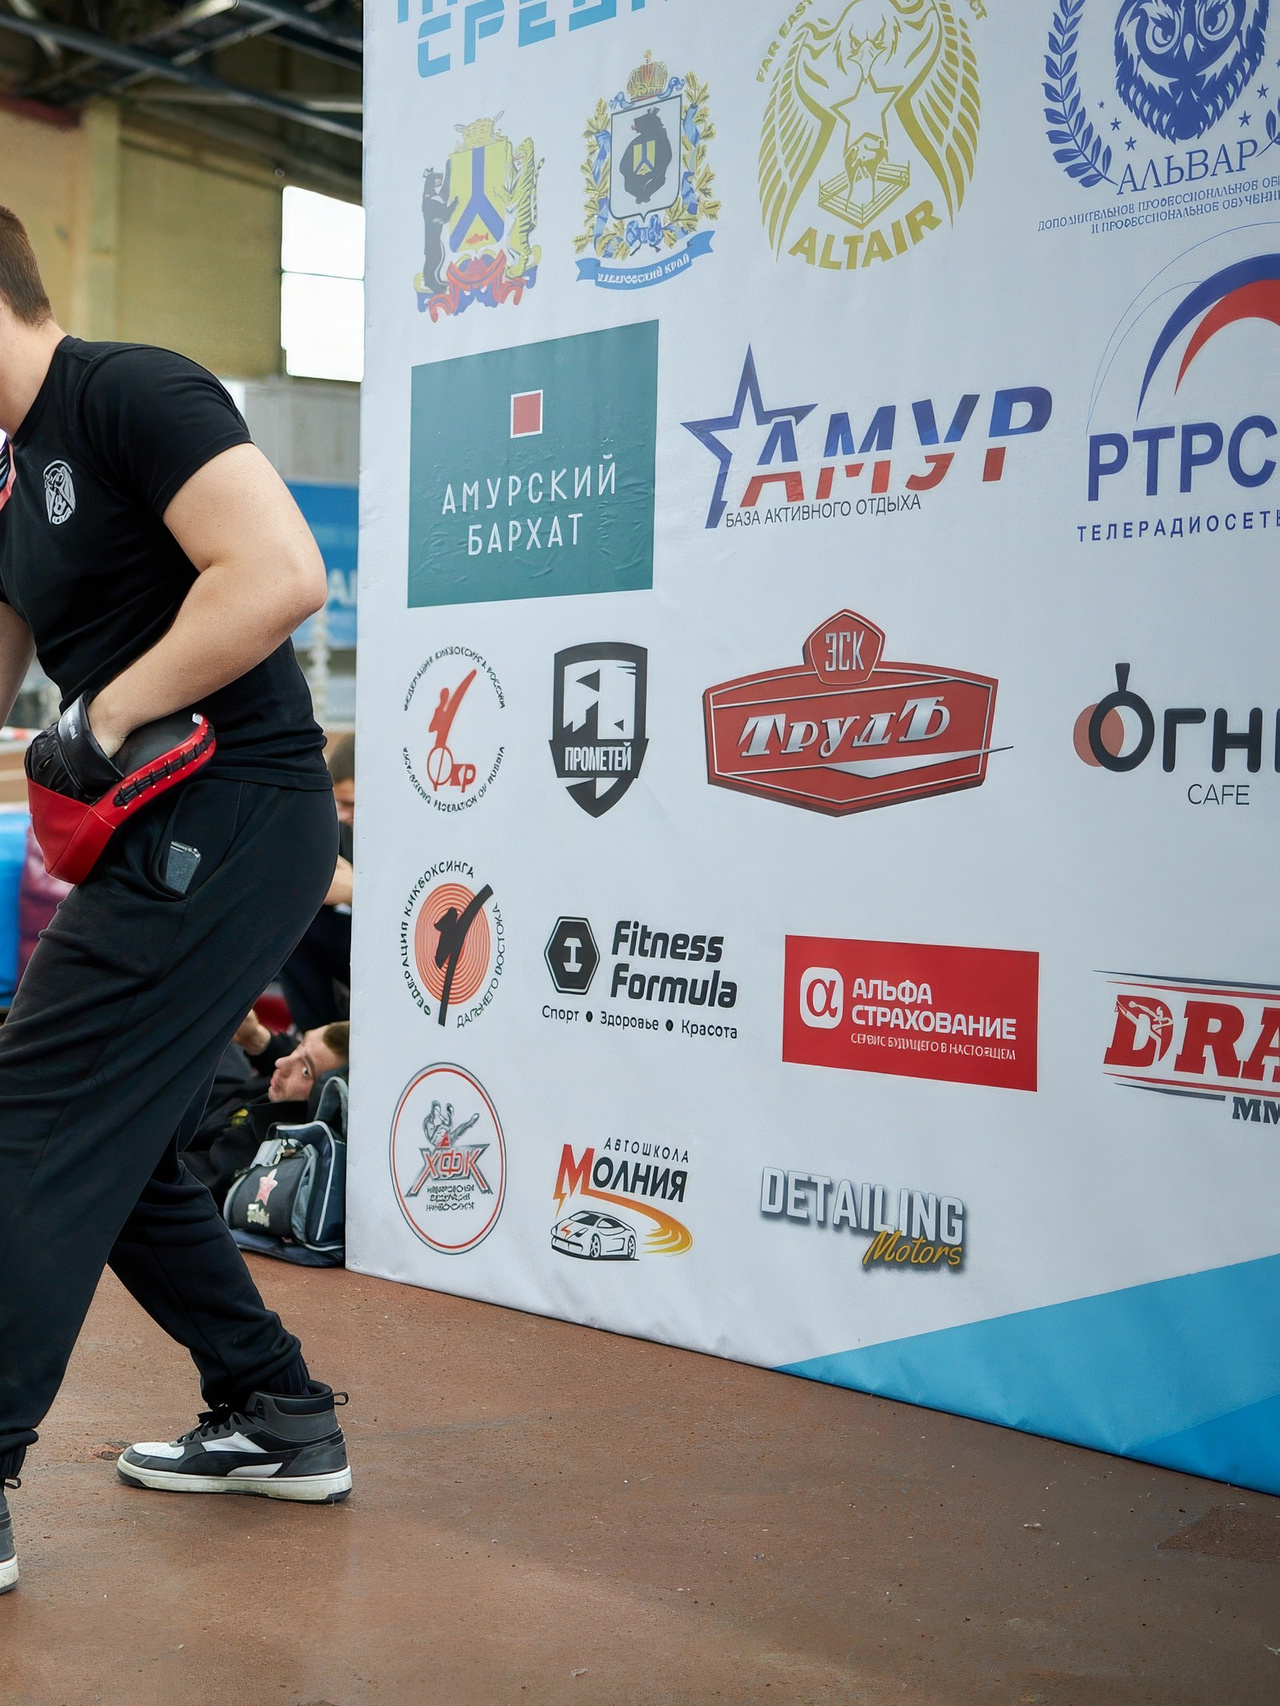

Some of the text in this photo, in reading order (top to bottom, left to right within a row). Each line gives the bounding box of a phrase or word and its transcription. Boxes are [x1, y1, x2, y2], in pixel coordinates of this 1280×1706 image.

[1116, 138, 1259, 196] АЛЬВАР
[1262, 174, 1280, 189] ОБ
[789, 199, 943, 270] ALTAIR
[739, 385, 1053, 508] АМУР
[1088, 415, 1278, 502] РТРС
[442, 453, 617, 515] АМУРСКИЙ
[726, 493, 921, 528] БАЗА АКТИВНОГО ОТДЫХА
[1077, 509, 1280, 543] ТЕЛЕРАДИОСЕТ
[468, 513, 584, 556] БАРХАТ
[823, 629, 867, 672] ЭСК
[1088, 663, 1280, 774] ОГН
[564, 741, 632, 772] ПРОМЕТЕЙ
[1187, 784, 1250, 806] CAFE
[611, 920, 725, 963] Fitness
[610, 963, 738, 1009] Formula
[852, 977, 933, 1005] АЛЬФА
[542, 1004, 738, 1040] Спорт Здоровье Красота
[851, 1004, 1017, 1040] СТРАХОВАНИЕ
[940, 1042, 947, 1054] В
[604, 1137, 689, 1163] АВТОШКОЛА
[553, 1144, 688, 1203] МОЛНИЯ
[761, 1166, 966, 1246] DETAILING
[862, 1229, 962, 1267] Motors
